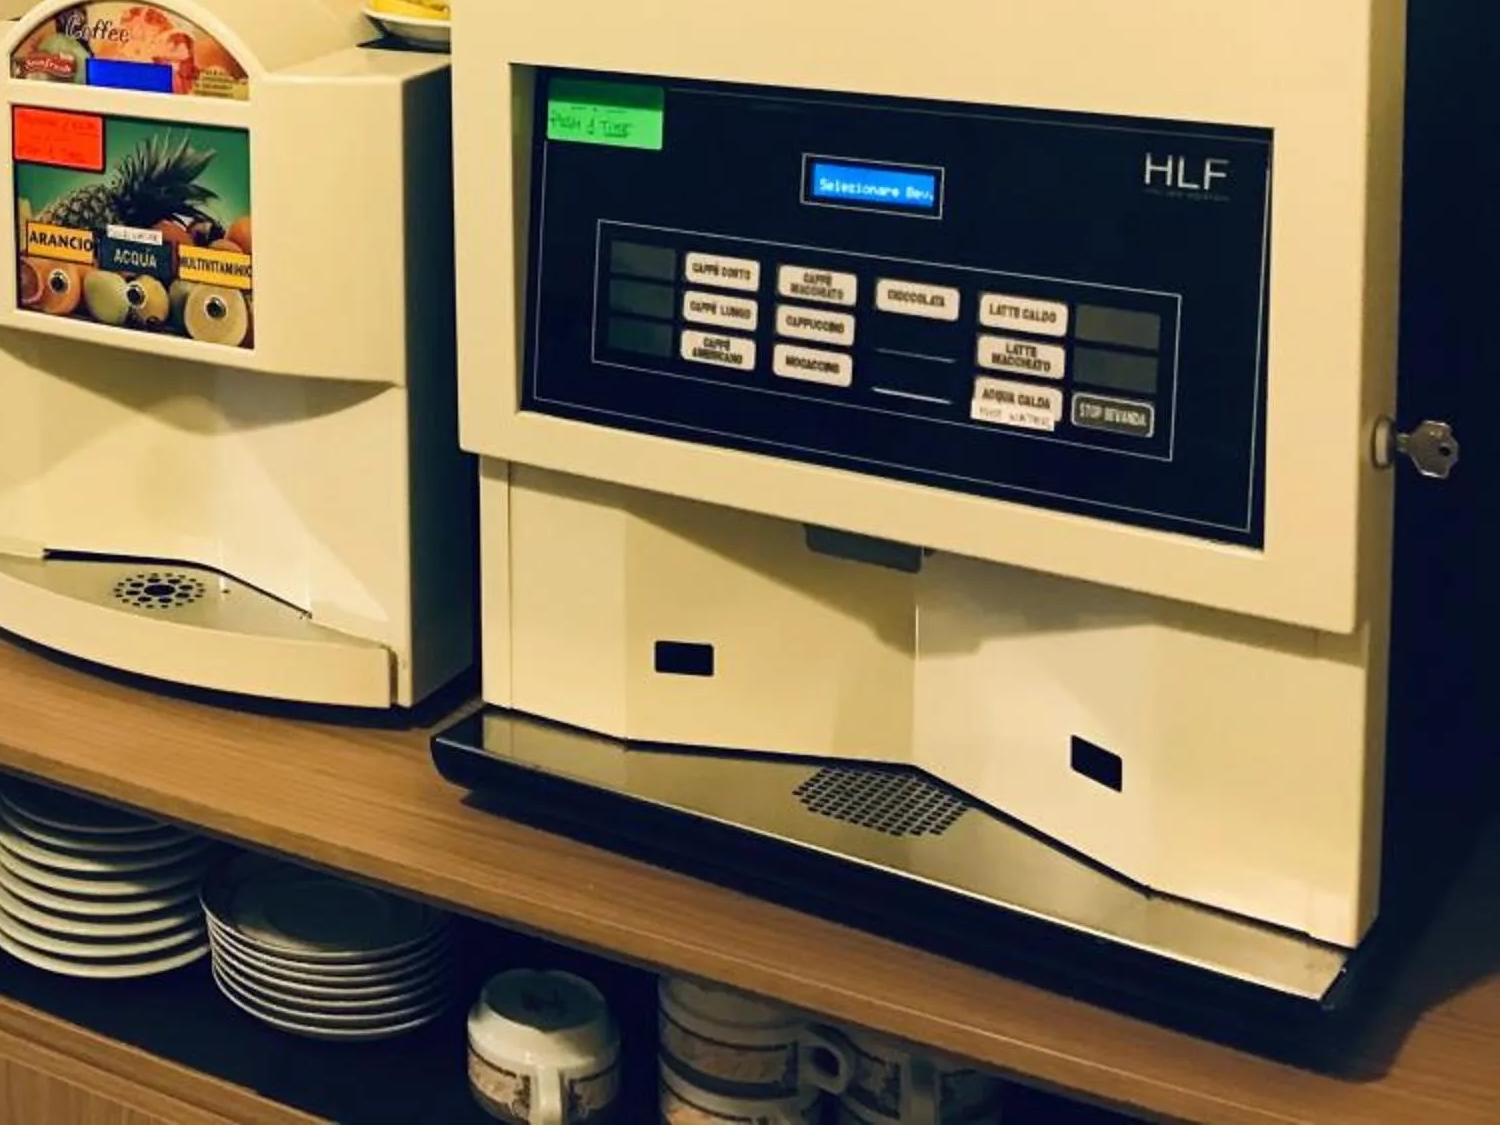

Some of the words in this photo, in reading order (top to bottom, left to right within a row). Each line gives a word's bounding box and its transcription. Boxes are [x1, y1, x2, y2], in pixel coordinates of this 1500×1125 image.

[65, 12, 130, 43] Coffee
[1144, 153, 1230, 190] HLF
[819, 177, 900, 197] Selezionare
[29, 230, 95, 252] ARANCIO
[113, 247, 157, 268] ACQUA
[988, 303, 1020, 319] LATTE
[1021, 308, 1057, 324] CALDO
[785, 314, 845, 335] CAPPUCCINO
[1005, 342, 1038, 357] LATTE
[991, 353, 1051, 372] MACCHIATO
[1017, 394, 1051, 409] CALDA
[1079, 402, 1102, 418] STOP
